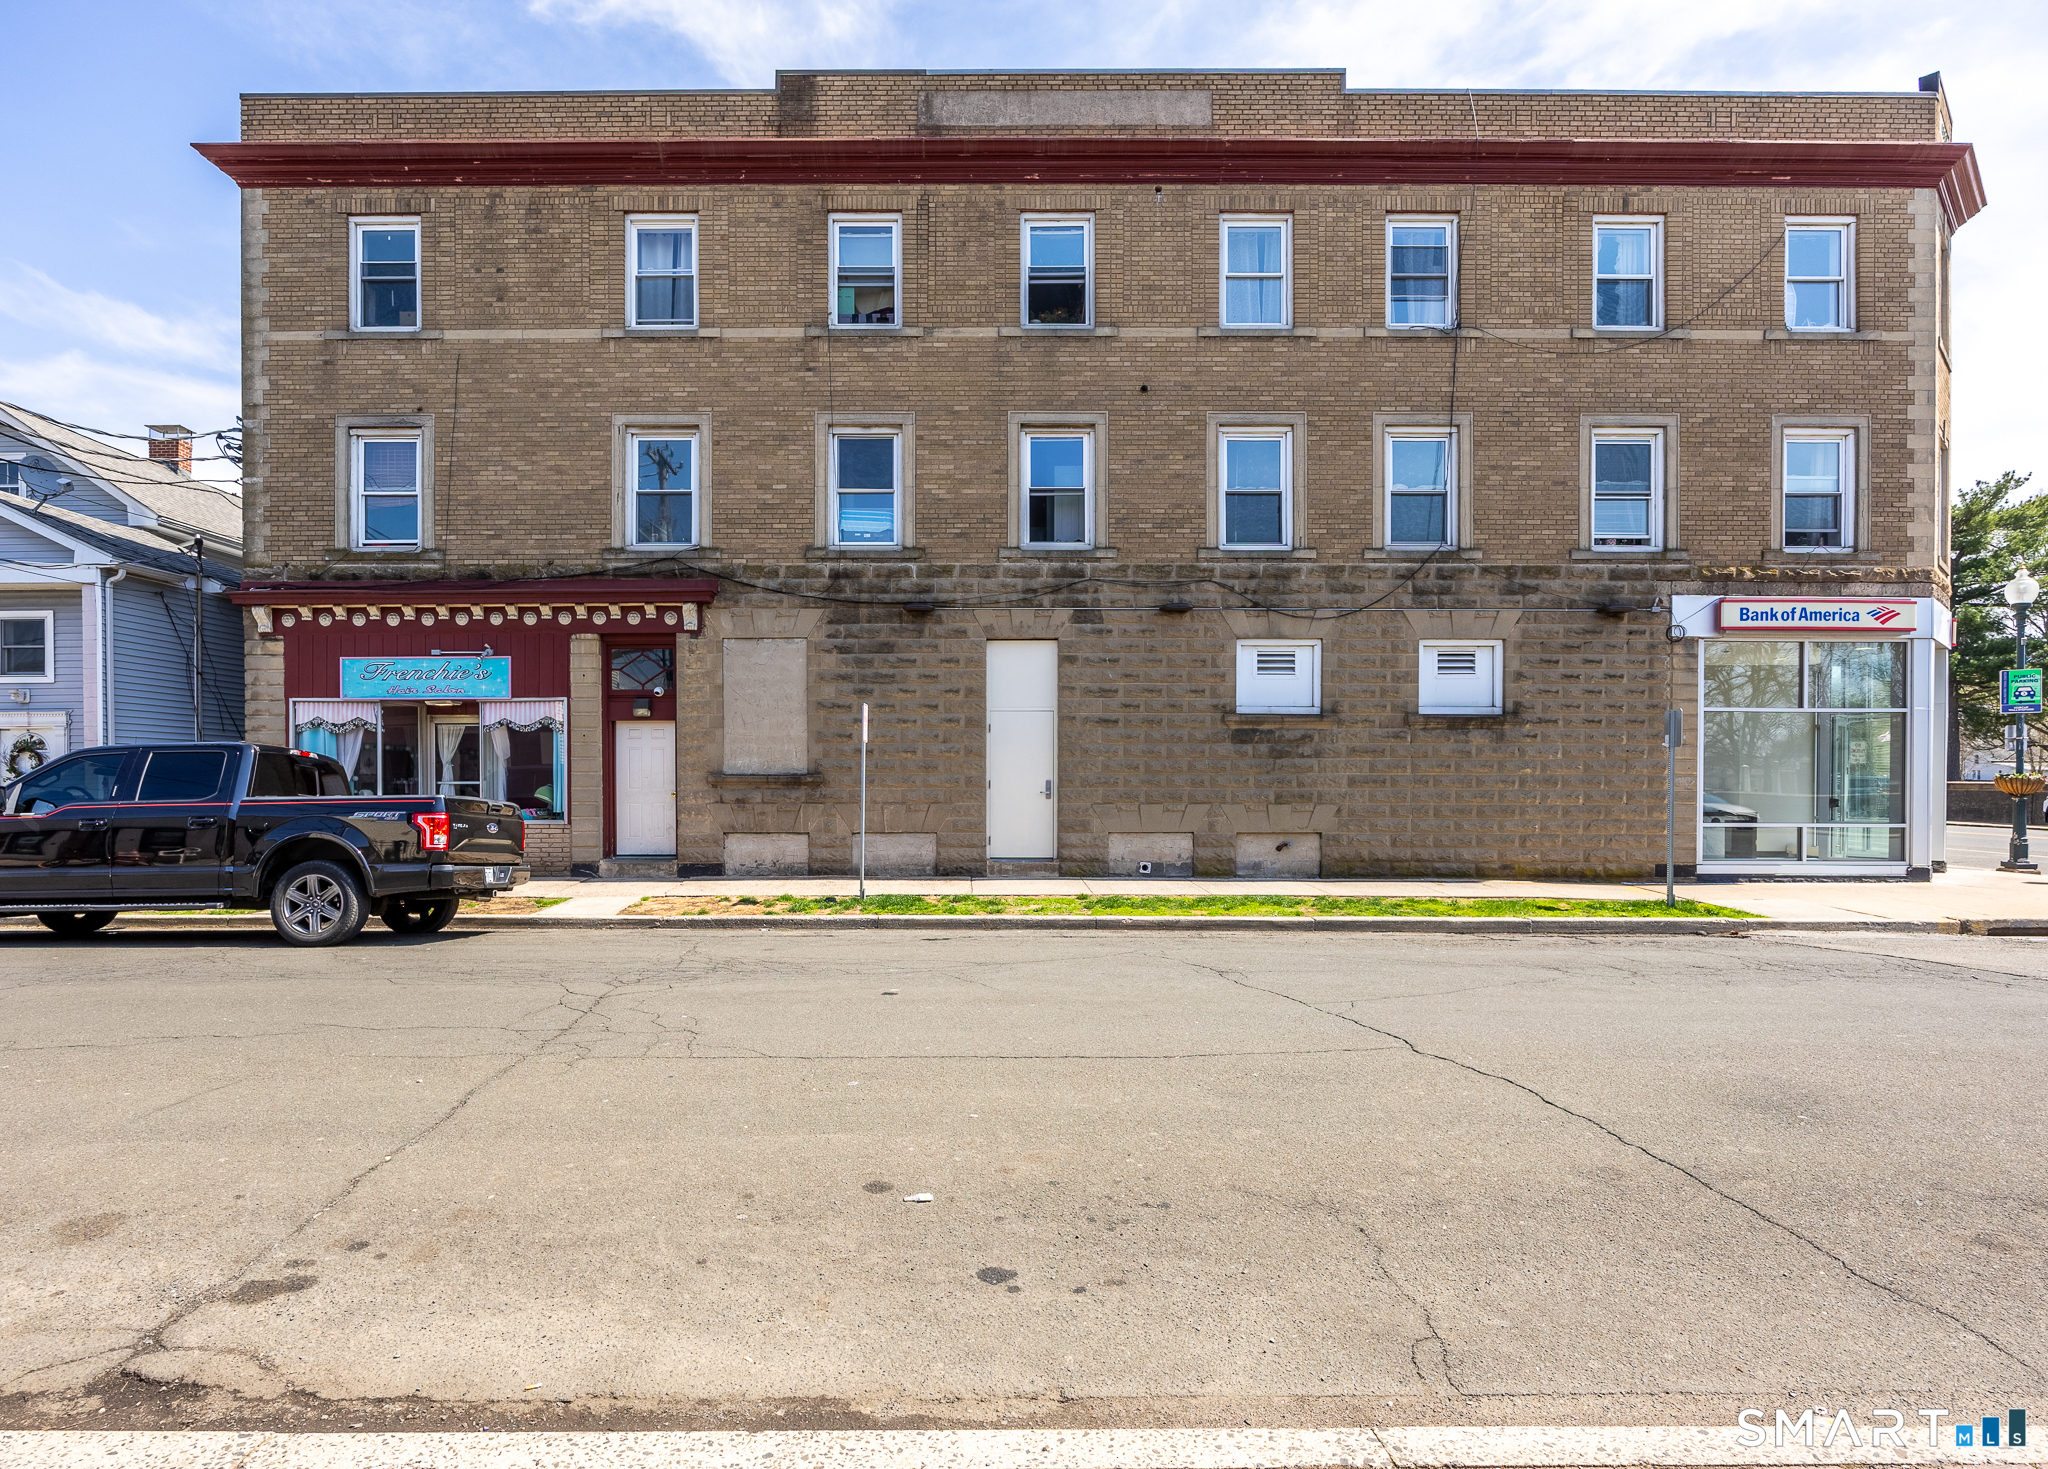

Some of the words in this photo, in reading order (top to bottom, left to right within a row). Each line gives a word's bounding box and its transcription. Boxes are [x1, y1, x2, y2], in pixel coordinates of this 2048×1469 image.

[1739, 607, 1779, 622] Bank
[1781, 607, 1797, 622] of
[1799, 607, 1860, 622] America
[360, 661, 492, 681] Frenchie's
[387, 685, 419, 695] Hair
[422, 685, 466, 695] Salon
